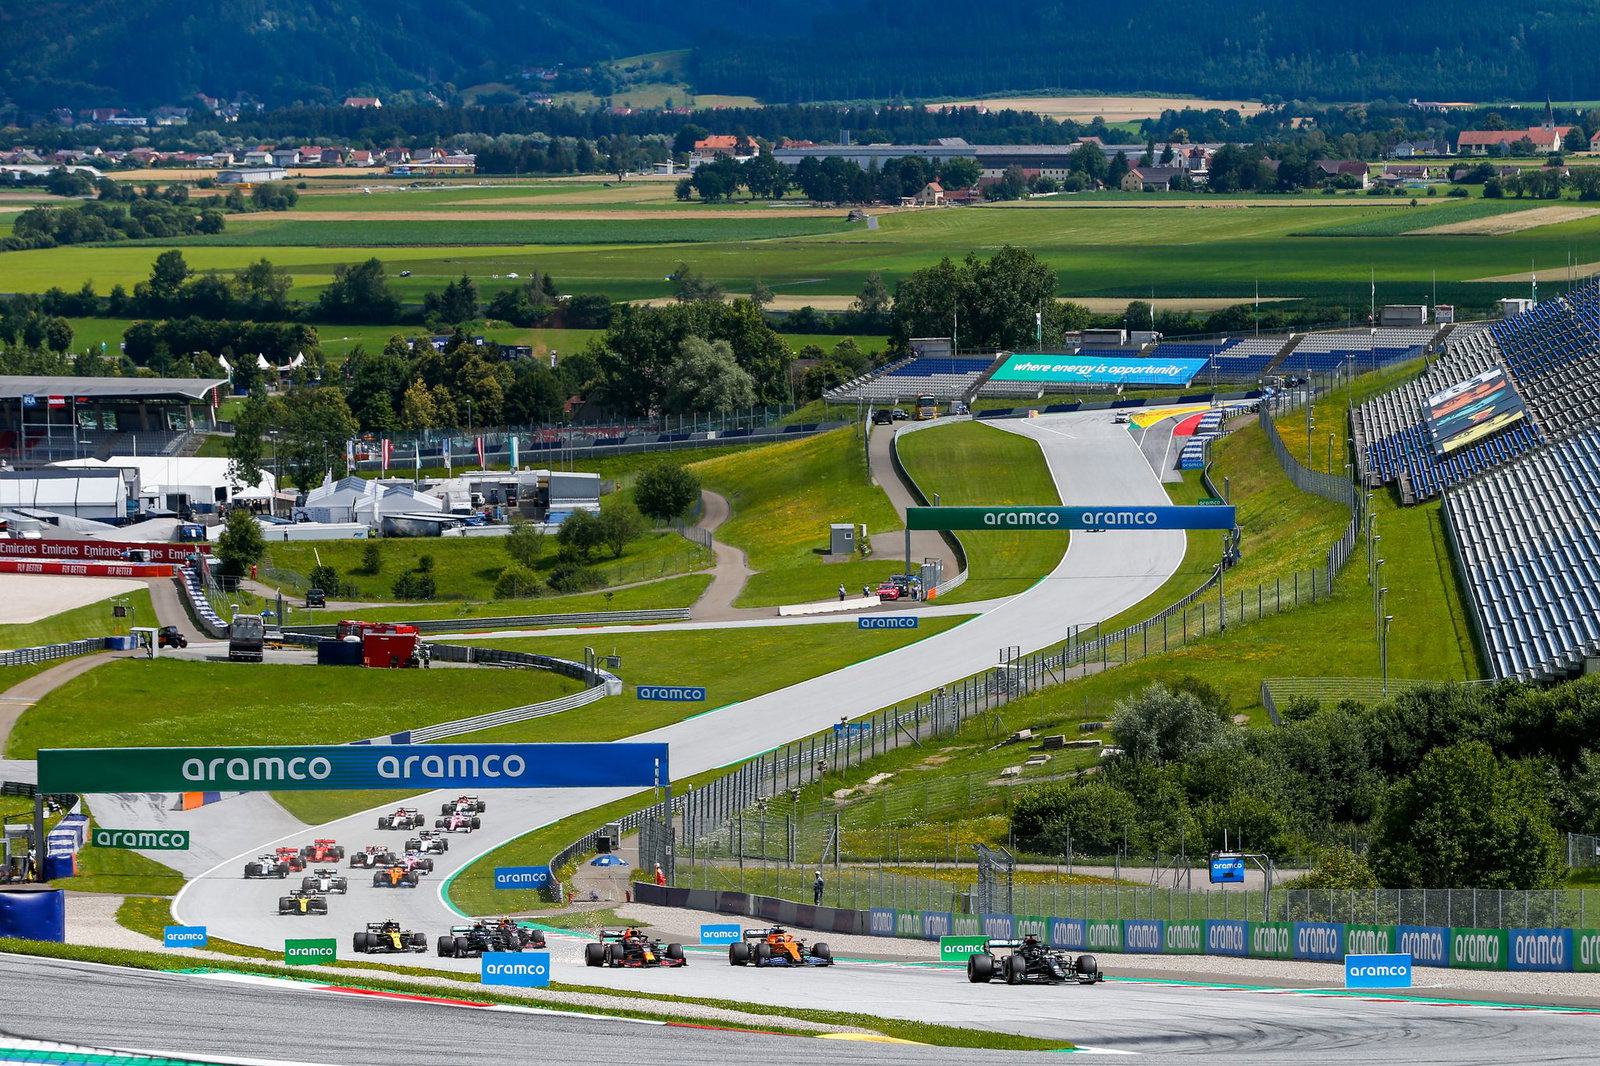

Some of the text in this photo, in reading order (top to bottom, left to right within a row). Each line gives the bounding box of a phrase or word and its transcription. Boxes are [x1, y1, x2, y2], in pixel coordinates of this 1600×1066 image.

[1014, 362, 1184, 376] where energy is opportunity
[983, 512, 1157, 525] aramco aramco
[0, 543, 37, 554] Emirates
[41, 543, 79, 556] Emirates
[84, 545, 121, 557] Emirates
[26, 564, 43, 572] BETTER
[71, 565, 87, 574] BETTER
[116, 567, 133, 575] BETTER
[861, 617, 914, 628] aramco
[641, 688, 701, 700] aramco
[182, 754, 526, 781] aramco aramco
[97, 831, 185, 847] aramco
[1213, 861, 1242, 869] aramco
[497, 872, 547, 882] aramco
[167, 932, 204, 940] aramco
[703, 930, 738, 938] aramco
[1053, 923, 1082, 946] aramco
[1089, 924, 1119, 947] aramco
[1128, 925, 1159, 949] aramco
[1167, 925, 1200, 950] aramco
[1210, 926, 1243, 951] aramco
[1254, 927, 1289, 953] aramco
[1299, 927, 1337, 954] aramco
[1348, 929, 1388, 954] aramco
[1401, 932, 1442, 961] aramco
[288, 947, 333, 956] aramco
[1455, 934, 1498, 964] aramco
[1515, 935, 1563, 965] aramco
[486, 964, 545, 975] aramco
[1350, 966, 1407, 976] aramco
